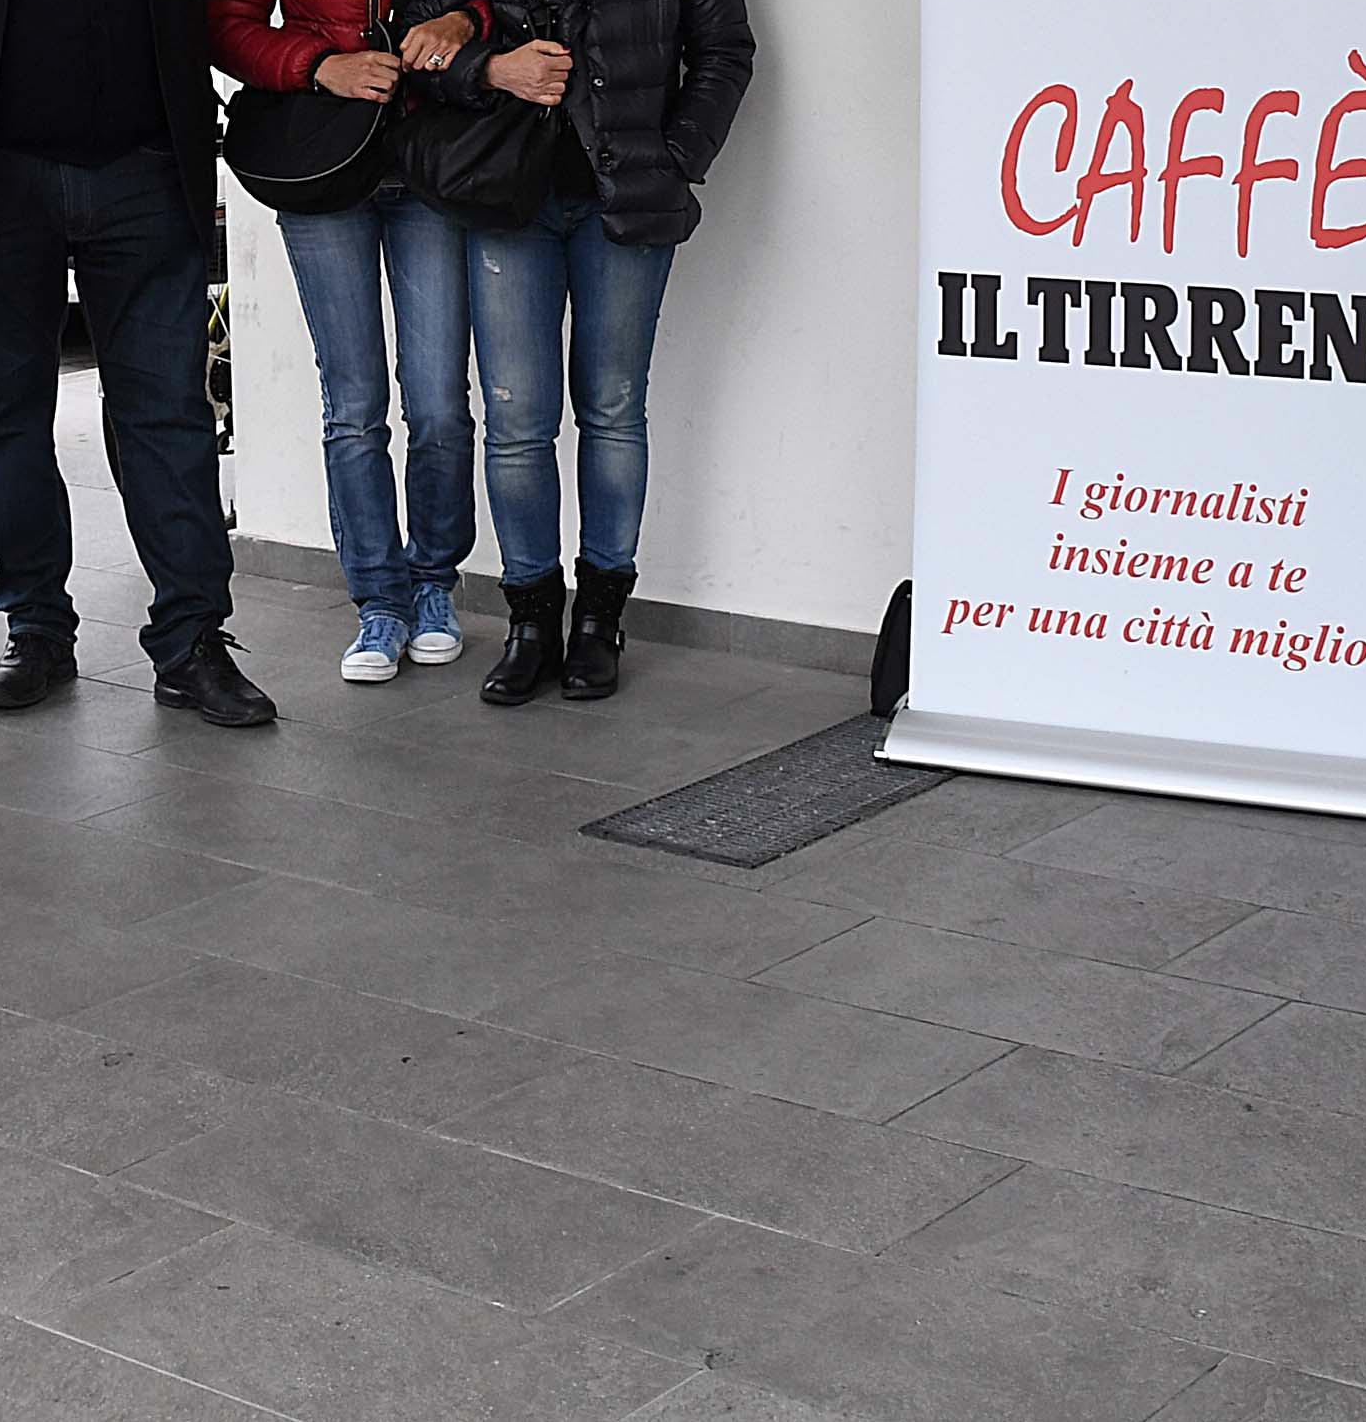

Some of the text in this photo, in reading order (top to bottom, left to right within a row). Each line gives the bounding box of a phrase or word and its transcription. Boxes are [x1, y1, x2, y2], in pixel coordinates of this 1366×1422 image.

[938, 271, 1018, 361] IL
[1048, 467, 1310, 527] I giornalisti
[1048, 533, 1308, 593] insieme a te
[941, 596, 1015, 635] per
[1027, 605, 1108, 640] una
[1123, 607, 1215, 651] città
